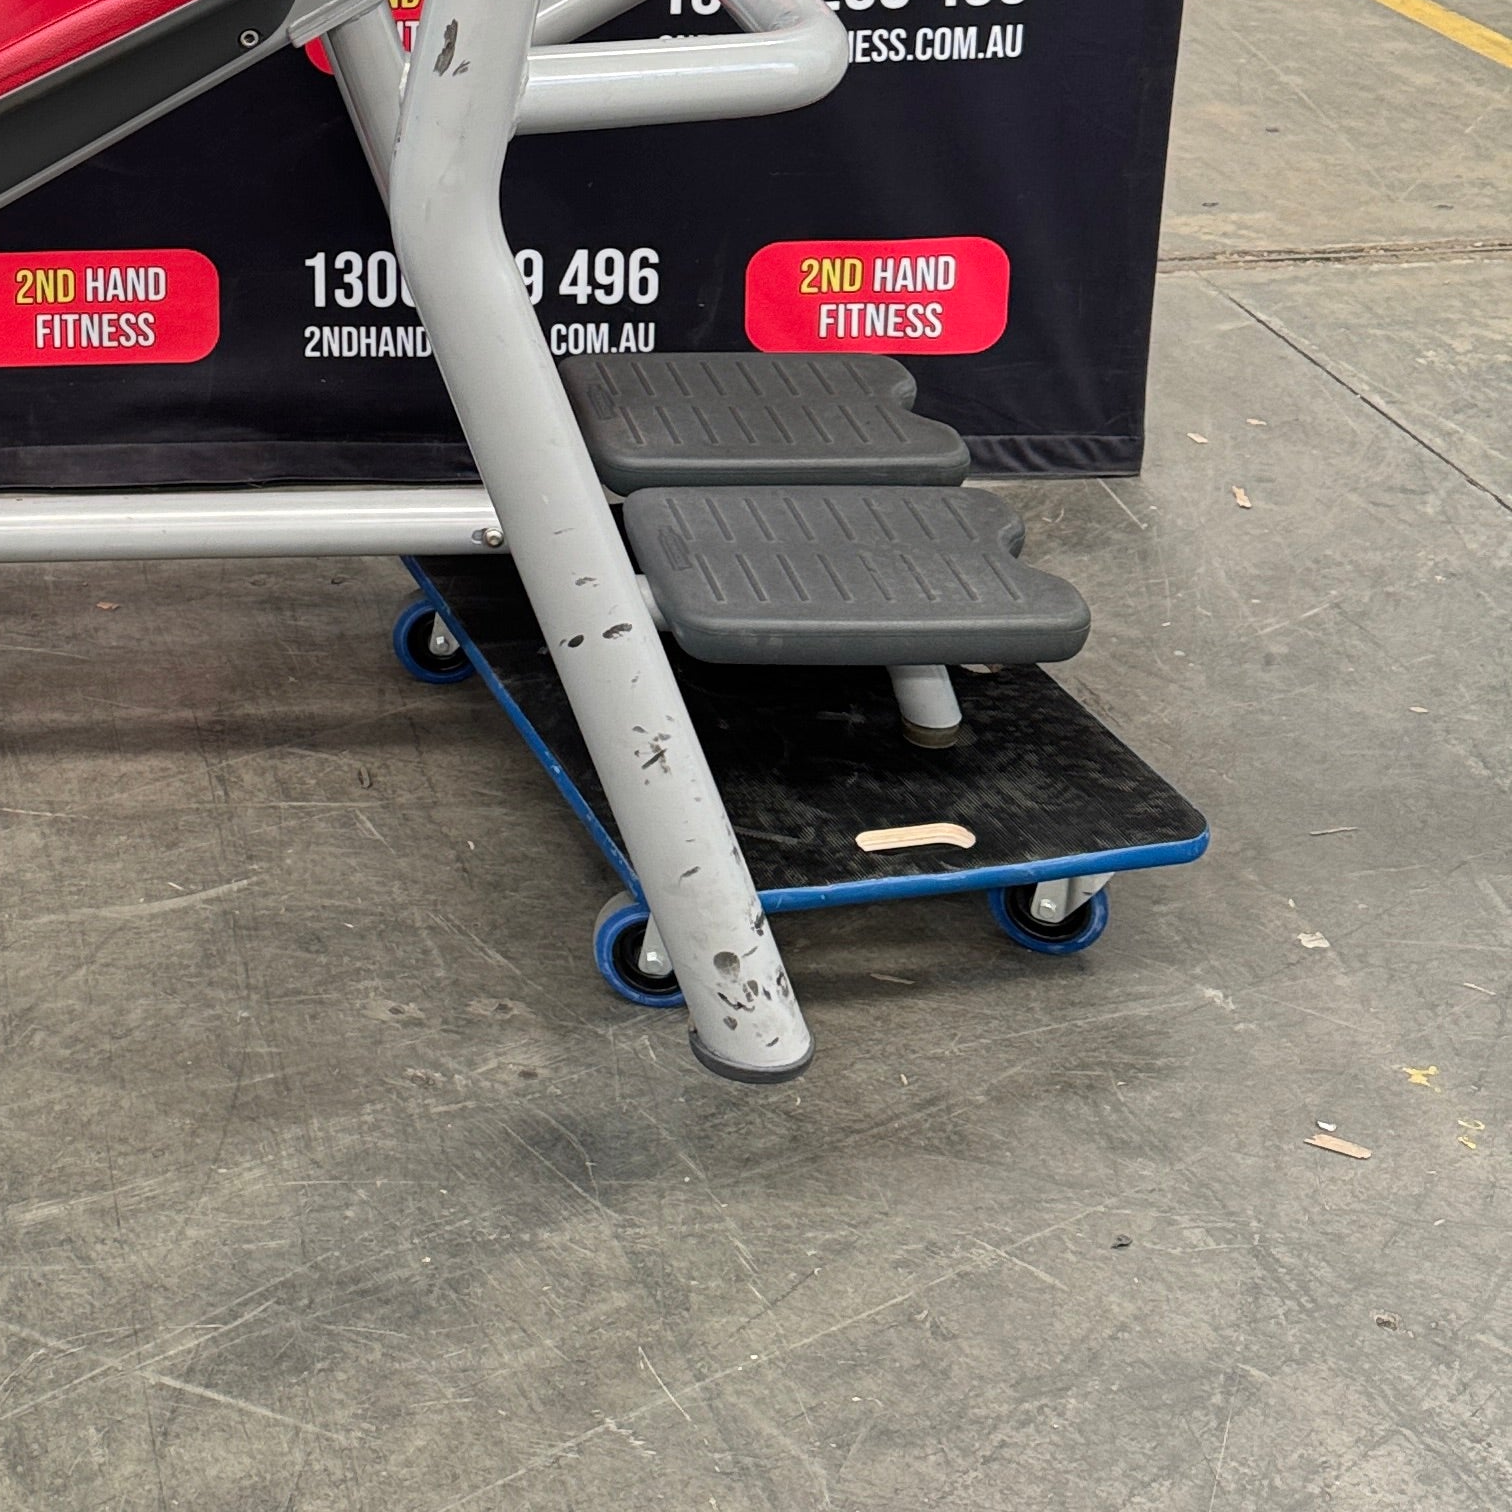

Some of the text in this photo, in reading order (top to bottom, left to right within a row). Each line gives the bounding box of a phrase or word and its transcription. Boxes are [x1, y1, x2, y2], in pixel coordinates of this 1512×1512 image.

[16, 267, 166, 304] 2ND HAND
[304, 250, 417, 308] 130
[558, 248, 660, 305] 496
[800, 255, 957, 294] 2ND HAND
[36, 312, 155, 348] FITNESS
[819, 302, 943, 338] FITNESS
